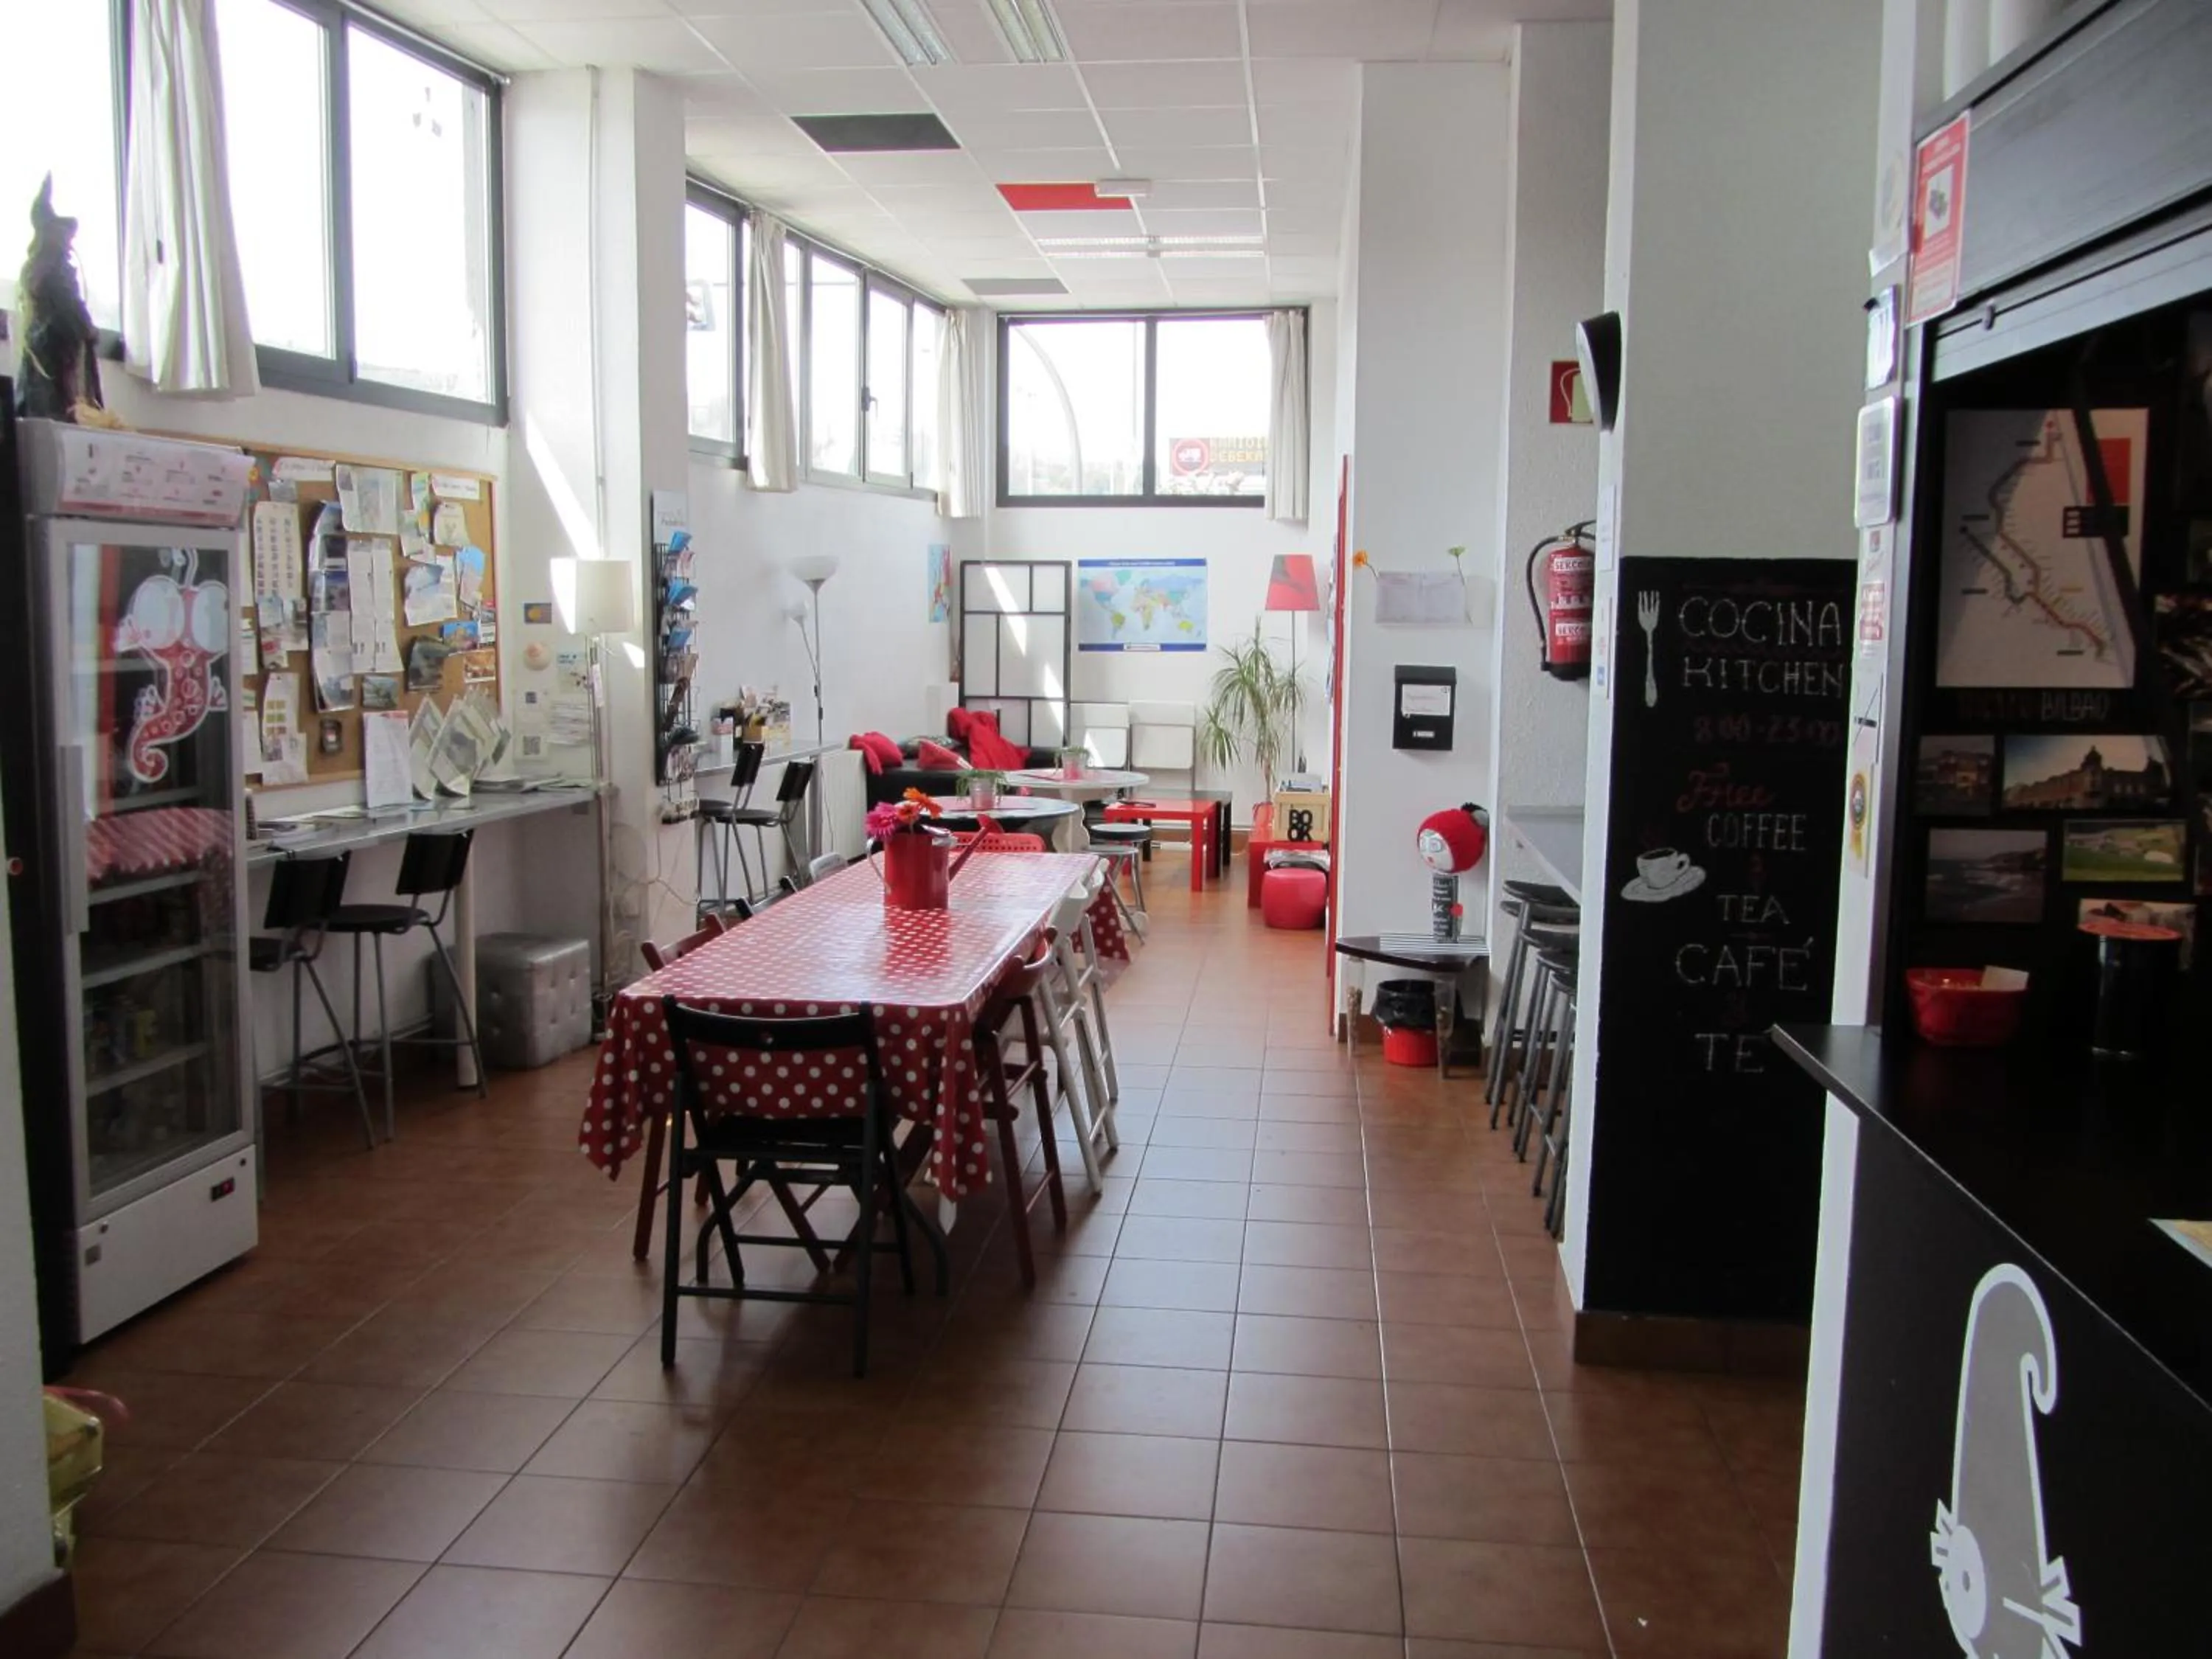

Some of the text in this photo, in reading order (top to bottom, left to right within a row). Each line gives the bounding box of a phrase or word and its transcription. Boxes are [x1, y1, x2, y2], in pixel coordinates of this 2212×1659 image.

[1679, 595, 1842, 647] COCINA
[1680, 655, 1844, 698] KITCHEN
[1707, 813, 1807, 851] COFFEE
[1716, 894, 1791, 925] TEA
[1674, 936, 1814, 992] CAFÉ
